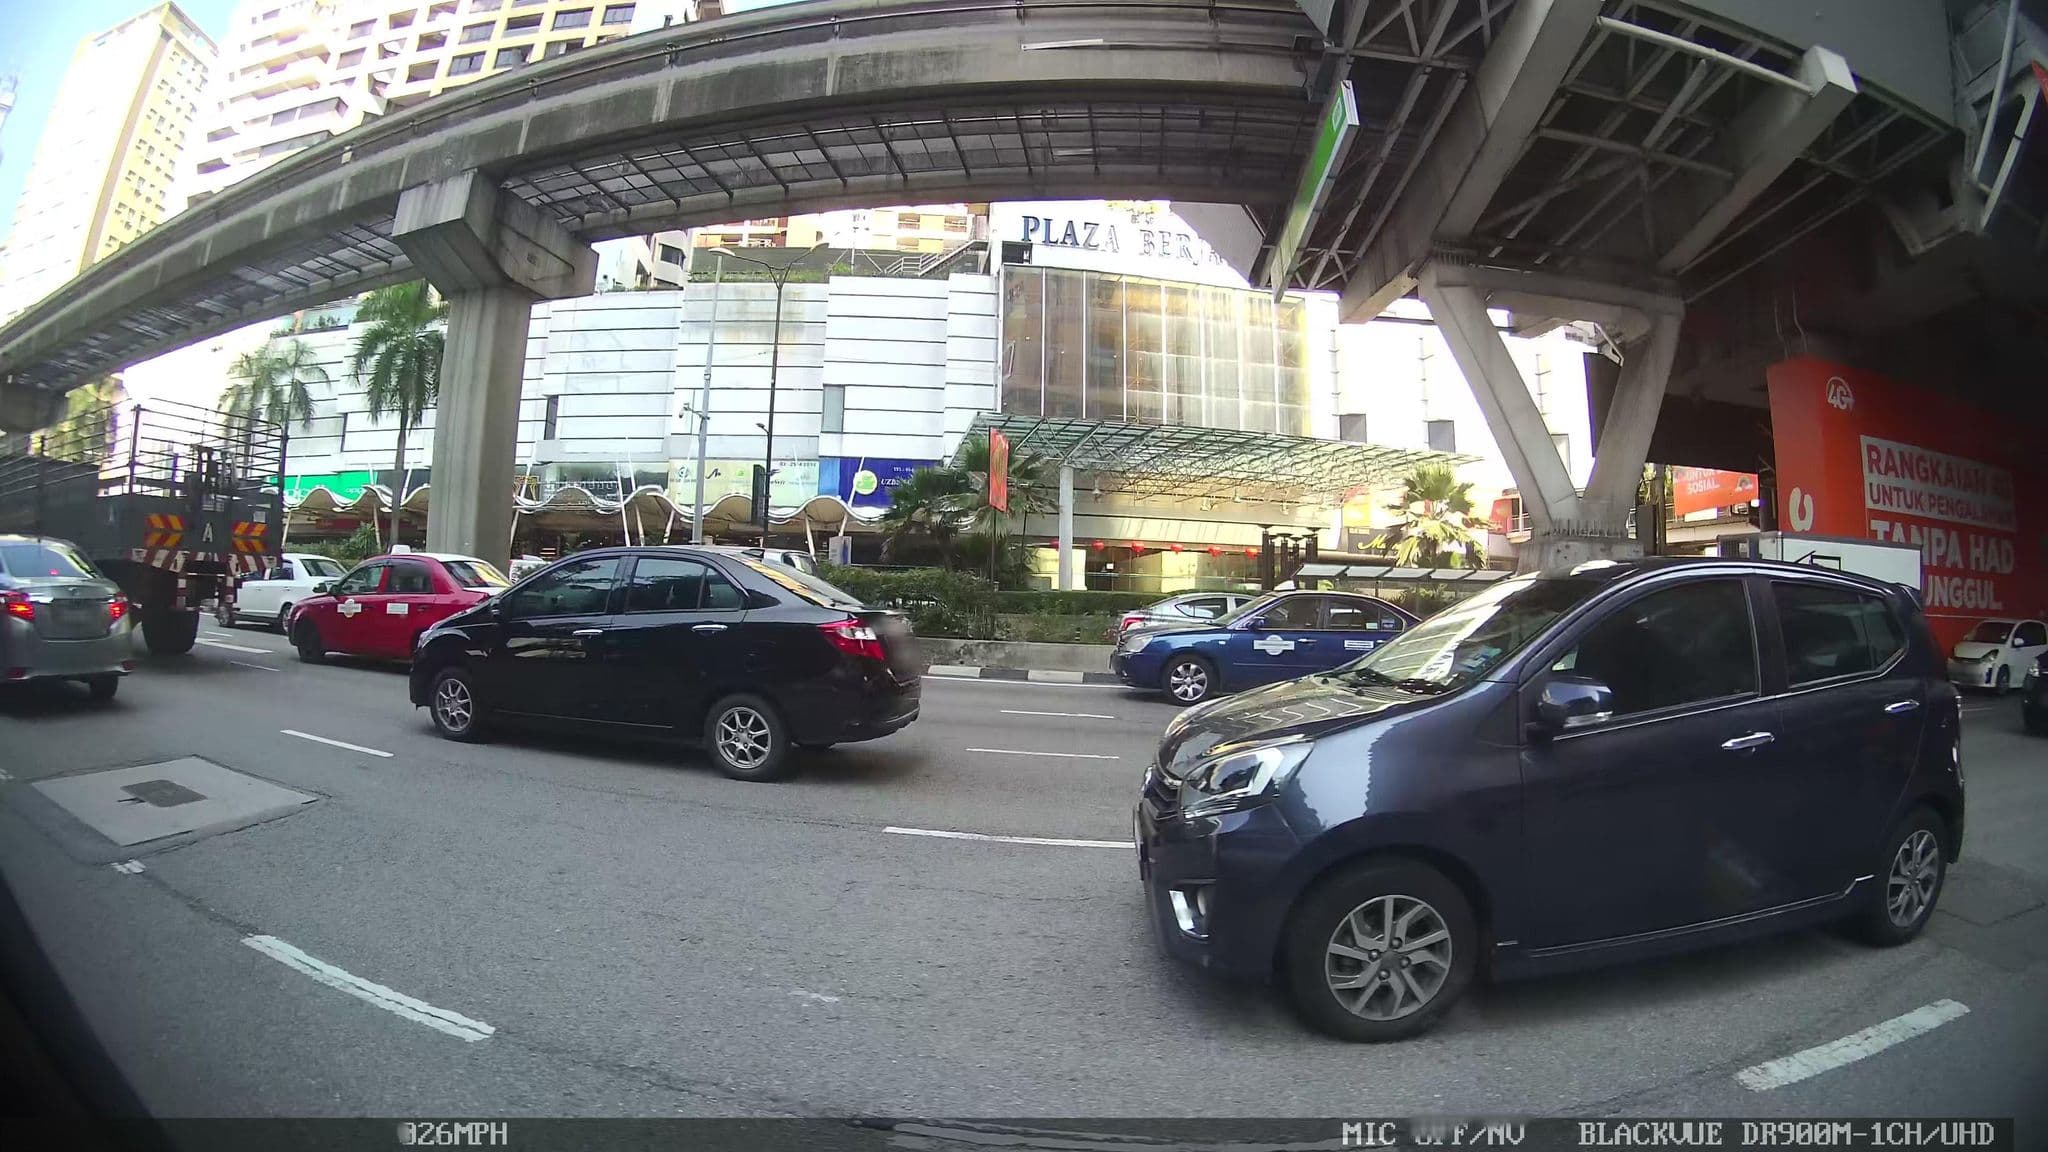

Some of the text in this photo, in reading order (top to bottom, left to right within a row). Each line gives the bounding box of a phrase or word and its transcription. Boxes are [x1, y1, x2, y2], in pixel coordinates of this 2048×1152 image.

[1021, 215, 1119, 253] PLAZA
[1827, 382, 1852, 411] 4G
[1869, 482, 1926, 513] UNTUK
[201, 521, 214, 543] A
[1969, 534, 2015, 576] HAD
